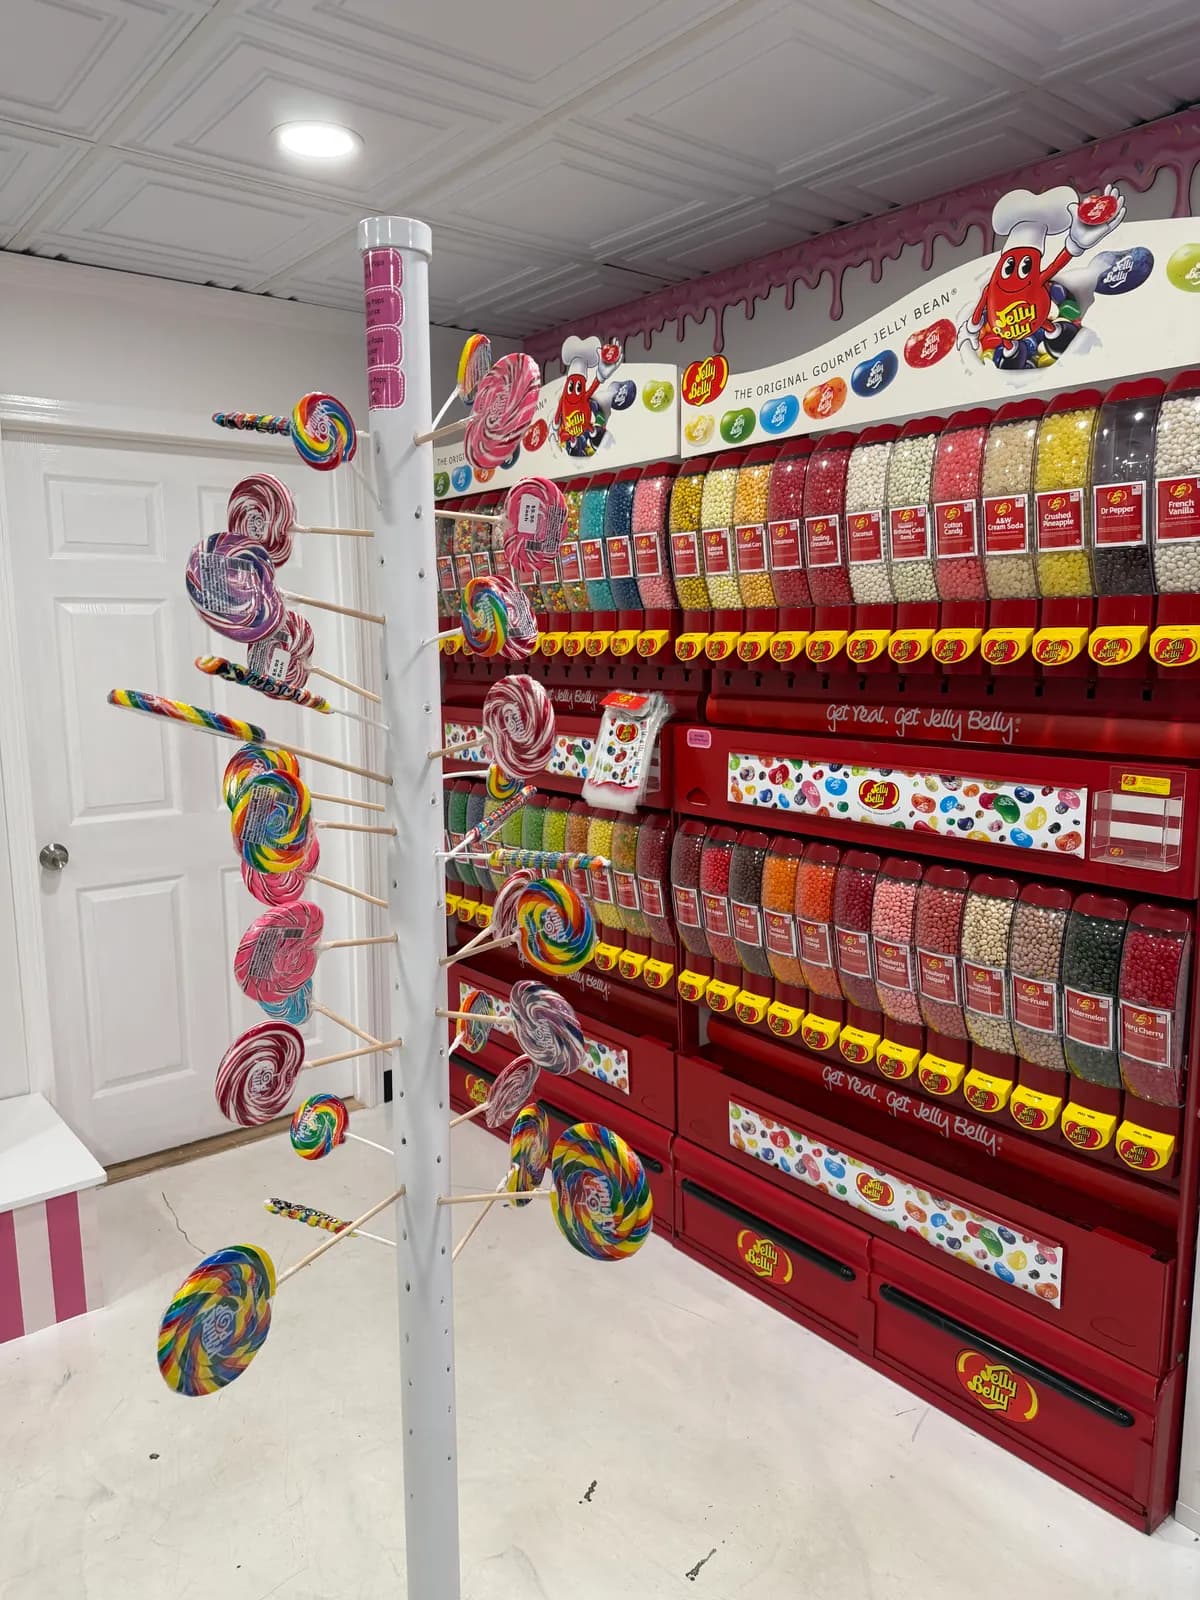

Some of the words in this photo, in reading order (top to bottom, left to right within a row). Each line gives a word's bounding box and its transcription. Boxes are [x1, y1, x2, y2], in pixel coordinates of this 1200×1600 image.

[1112, 255, 1134, 272] Jelly
[1104, 268, 1130, 288] Belly
[995, 300, 1037, 327] Jelly
[925, 329, 940, 347] Jelly
[993, 322, 1032, 341] Belly
[734, 387, 753, 400] THE
[756, 371, 808, 396] ORIGINAL
[812, 338, 869, 377] GOURMET
[873, 314, 908, 344] JELLY
[920, 343, 938, 360] Belly
[696, 356, 716, 382] Jelly
[870, 360, 884, 377] Jelly
[688, 380, 712, 406] Belly
[1100, 507, 1108, 515] Dr
[1109, 506, 1135, 515] Pepper
[1168, 499, 1196, 508] French
[1168, 506, 1195, 515] Vanilla
[995, 516, 1012, 524] A&W
[1043, 518, 1074, 528] Pineapple
[1044, 511, 1072, 521] Crushed
[943, 528, 963, 536] Candy
[987, 523, 1006, 531] Cream
[1006, 522, 1024, 530] Soda
[923, 708, 962, 741] Jelly
[871, 781, 889, 796] Jelly
[1068, 1006, 1107, 1023] Watermelon
[1124, 1021, 1138, 1032] Very
[1138, 1027, 1164, 1040] Cherry
[913, 1102, 950, 1138] Jelly
[753, 1239, 778, 1264] Jelly
[745, 1249, 773, 1276] Belly
[981, 1364, 1017, 1398] Jelly
[967, 1375, 1009, 1411] Belly
